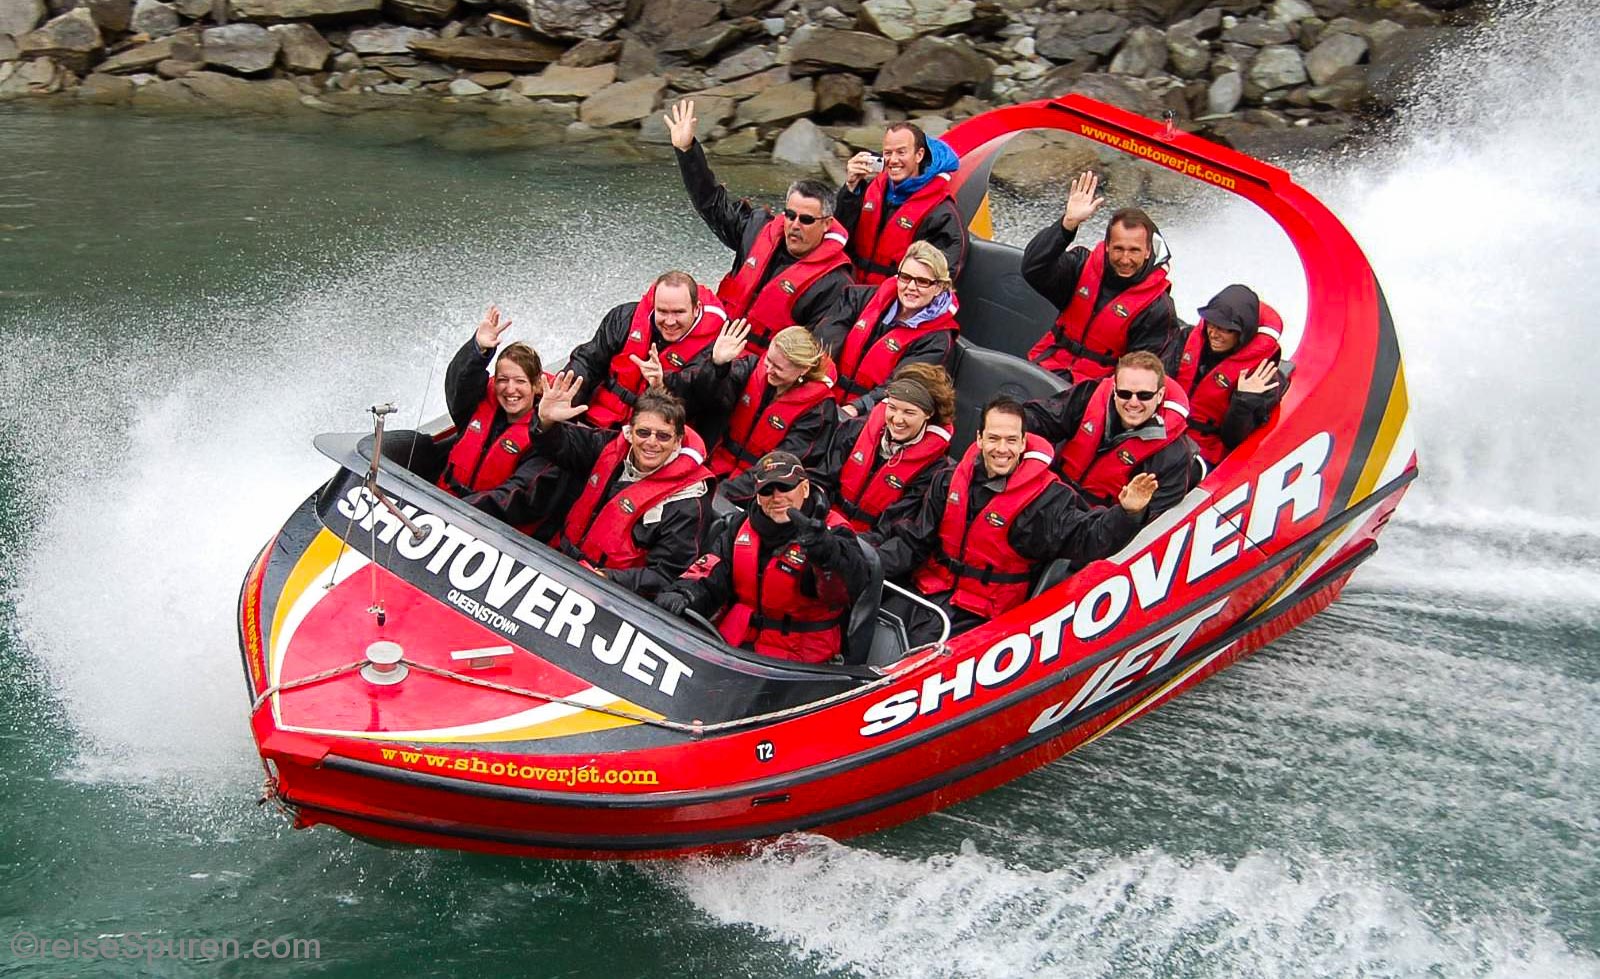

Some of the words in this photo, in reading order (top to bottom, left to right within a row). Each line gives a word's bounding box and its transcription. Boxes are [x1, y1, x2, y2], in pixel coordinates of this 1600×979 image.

[1081, 123, 1236, 190] www.shotoverjet.com
[337, 485, 596, 649] SHOTOVER
[591, 620, 694, 697] JET
[447, 589, 520, 636] QUEENSTOWN
[860, 431, 1333, 737] SHOTOVER
[1027, 596, 1230, 735] JET
[381, 748, 659, 786] www.shotoverjet.com
[756, 742, 774, 760] T2
